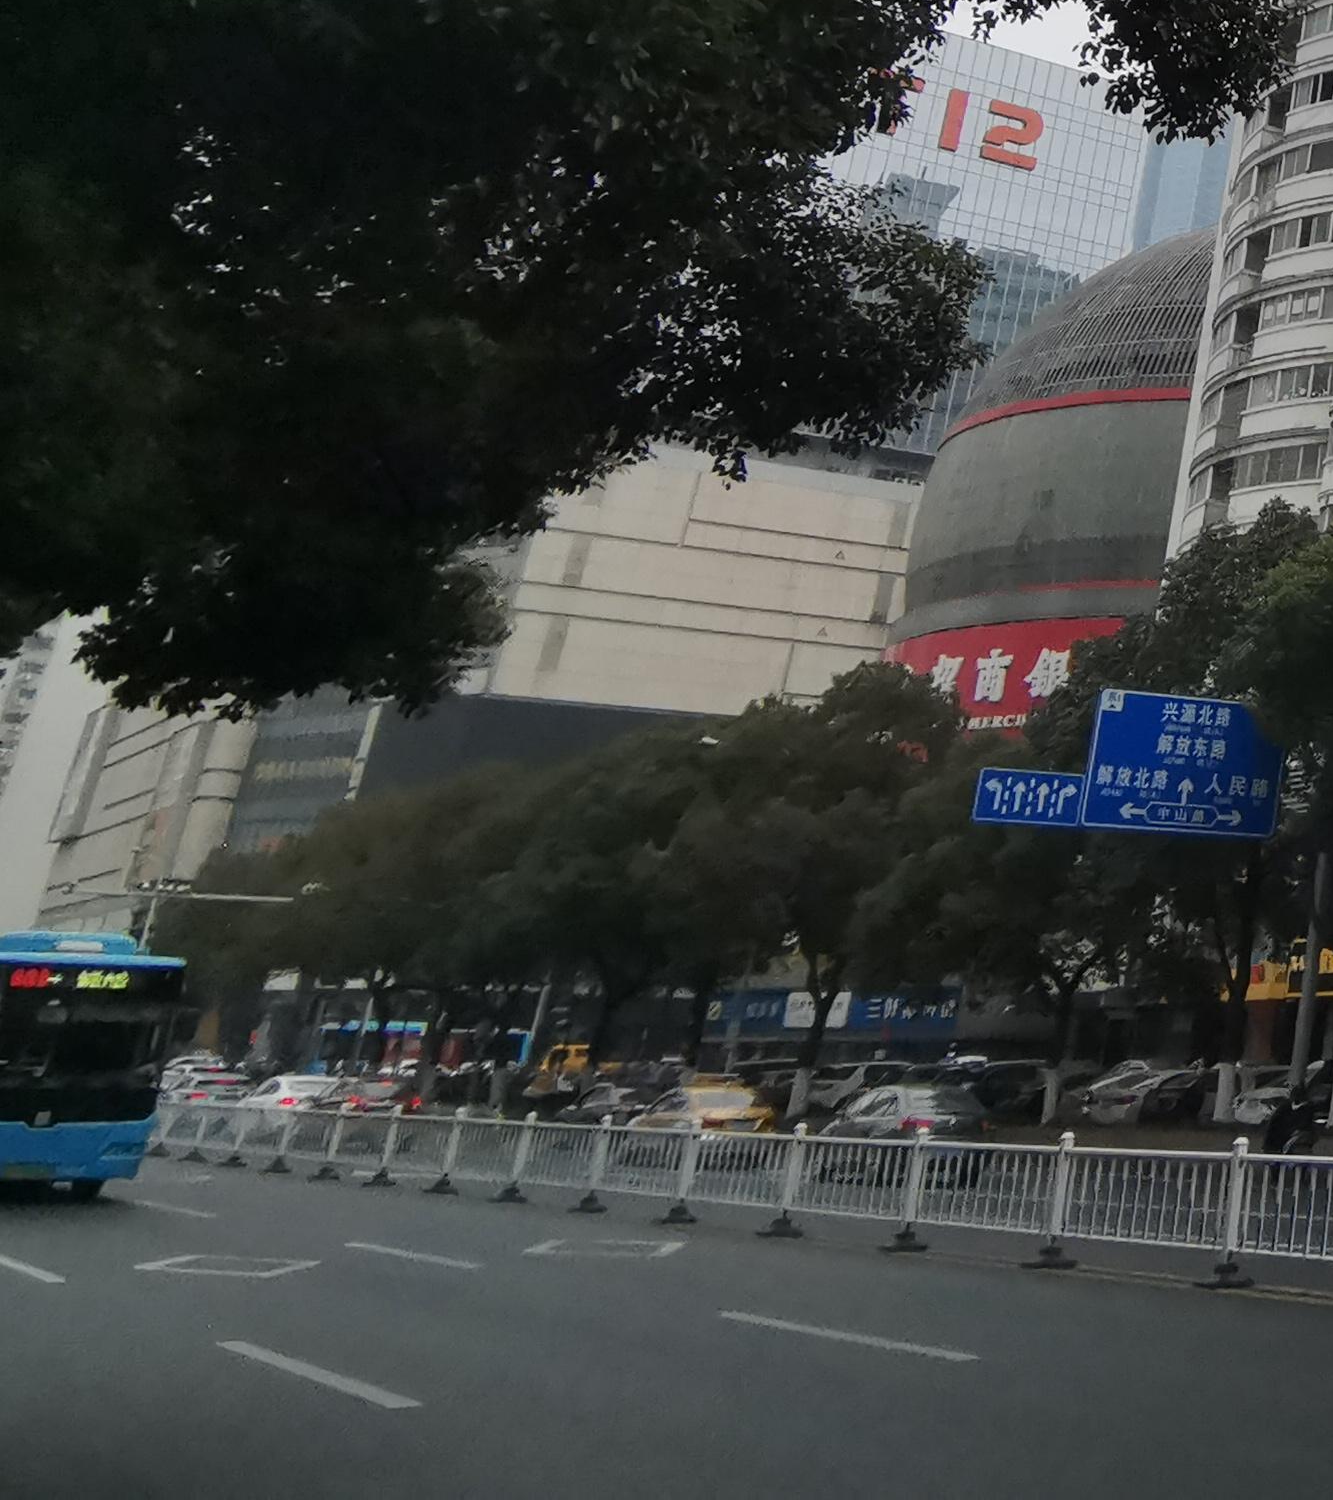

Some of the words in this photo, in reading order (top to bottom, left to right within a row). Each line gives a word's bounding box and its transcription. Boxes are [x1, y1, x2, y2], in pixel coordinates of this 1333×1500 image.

[1155, 733, 1227, 761] 解放东路
[1096, 764, 1169, 791] 解放北路
[1204, 773, 1269, 799] 人民路
[1157, 806, 1206, 824] 中山路
